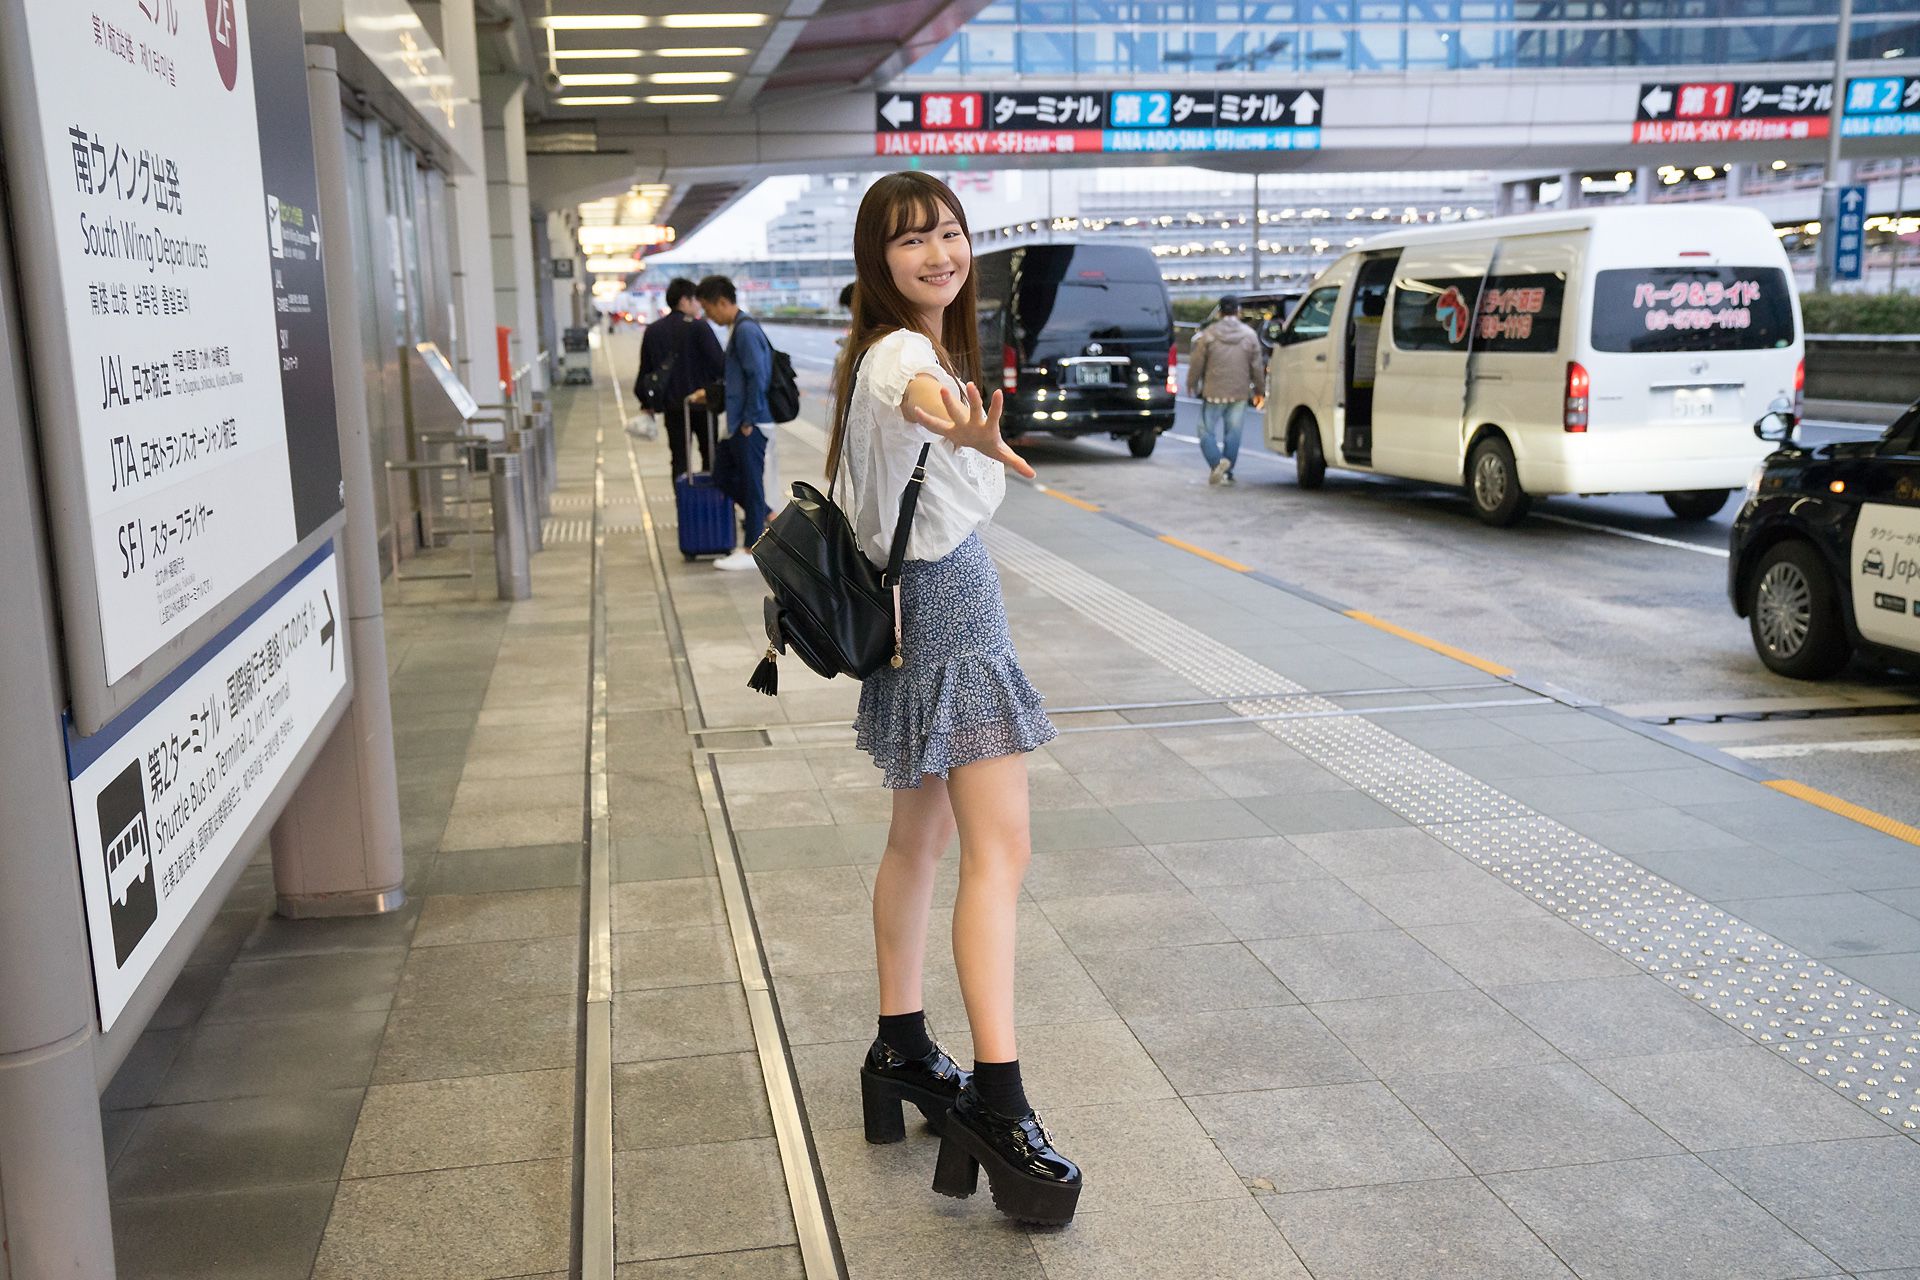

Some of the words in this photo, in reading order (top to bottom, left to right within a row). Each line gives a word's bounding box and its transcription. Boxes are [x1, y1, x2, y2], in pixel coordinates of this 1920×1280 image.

[925, 95, 975, 126] 第1
[994, 95, 1101, 124] ターミナル
[1115, 94, 1167, 124] 第2
[1173, 94, 1285, 122] ターミナル
[68, 124, 182, 215] 南ウイング出発
[80, 212, 120, 259] South
[120, 220, 155, 273] Wing
[154, 227, 209, 275] Departures
[101, 354, 130, 410] JAL
[132, 361, 171, 402] 日本航空
[110, 434, 139, 492] JTA
[141, 417, 237, 480] 日本トランスオーシャン航空
[118, 518, 145, 579] SFJ
[151, 502, 213, 559] スターフライヤー
[155, 792, 190, 855] Shuttle
[190, 778, 206, 813] Bus
[206, 767, 216, 793] to
[216, 731, 246, 781] Terminal
[247, 718, 255, 745] 2,
[266, 682, 289, 720] Terminal
